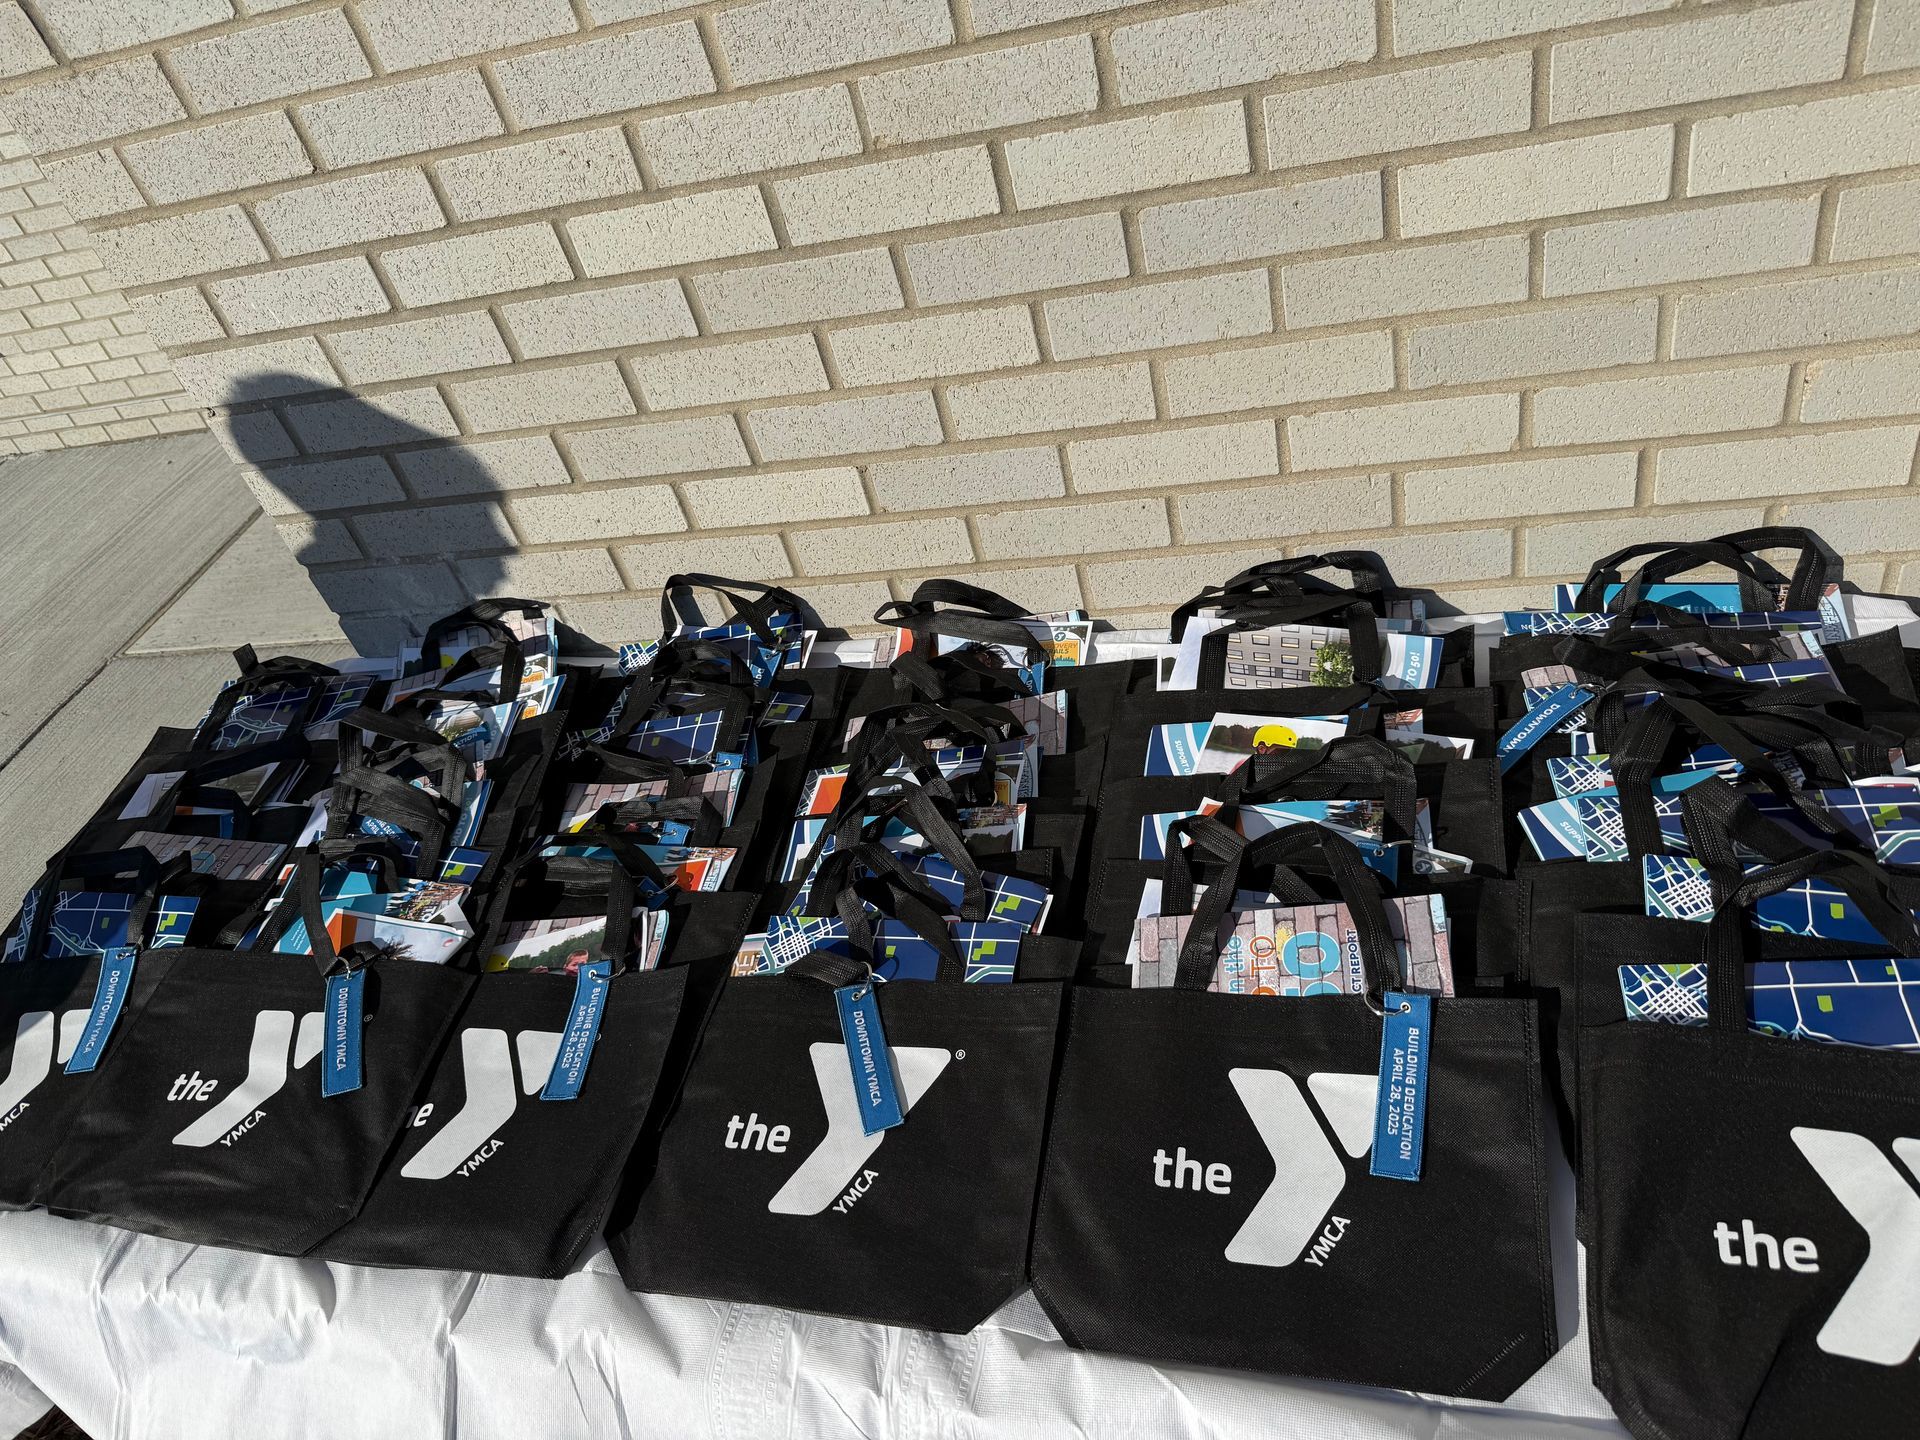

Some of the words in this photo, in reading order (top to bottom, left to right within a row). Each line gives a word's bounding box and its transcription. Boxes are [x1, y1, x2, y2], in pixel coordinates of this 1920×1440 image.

[1502, 703, 1561, 753] DOWNTOWN
[1560, 821, 1586, 845] SUPPO
[1249, 936, 1276, 979] TO
[1346, 929, 1361, 975] REPORT
[96, 970, 121, 1026] DOWNTOWN
[337, 987, 349, 1039] DOWNTOWN
[573, 1005, 587, 1030] APRIL
[584, 987, 601, 1029] BUILDING
[336, 1041, 347, 1072] YMCA
[562, 1046, 575, 1069] 2025
[567, 1031, 590, 1085] DEDICATION
[853, 1010, 876, 1074] DOWNTOWN
[867, 1073, 883, 1107] YMCA
[1391, 1047, 1404, 1083] APRIL
[1405, 1027, 1420, 1085] BUILDING
[167, 1071, 219, 1101] the
[1388, 1084, 1402, 1104] 28,
[0, 1102, 31, 1131] MCA
[220, 1110, 267, 1148] YMCA
[724, 1113, 791, 1154] the
[1387, 1106, 1400, 1136] 2025
[1400, 1087, 1416, 1160] DEDICATION
[457, 1138, 504, 1178] YMCA
[1153, 1147, 1232, 1194] the
[833, 1168, 879, 1213] YMCA
[1304, 1215, 1351, 1267] YMCA
[1713, 1218, 1820, 1273] the
